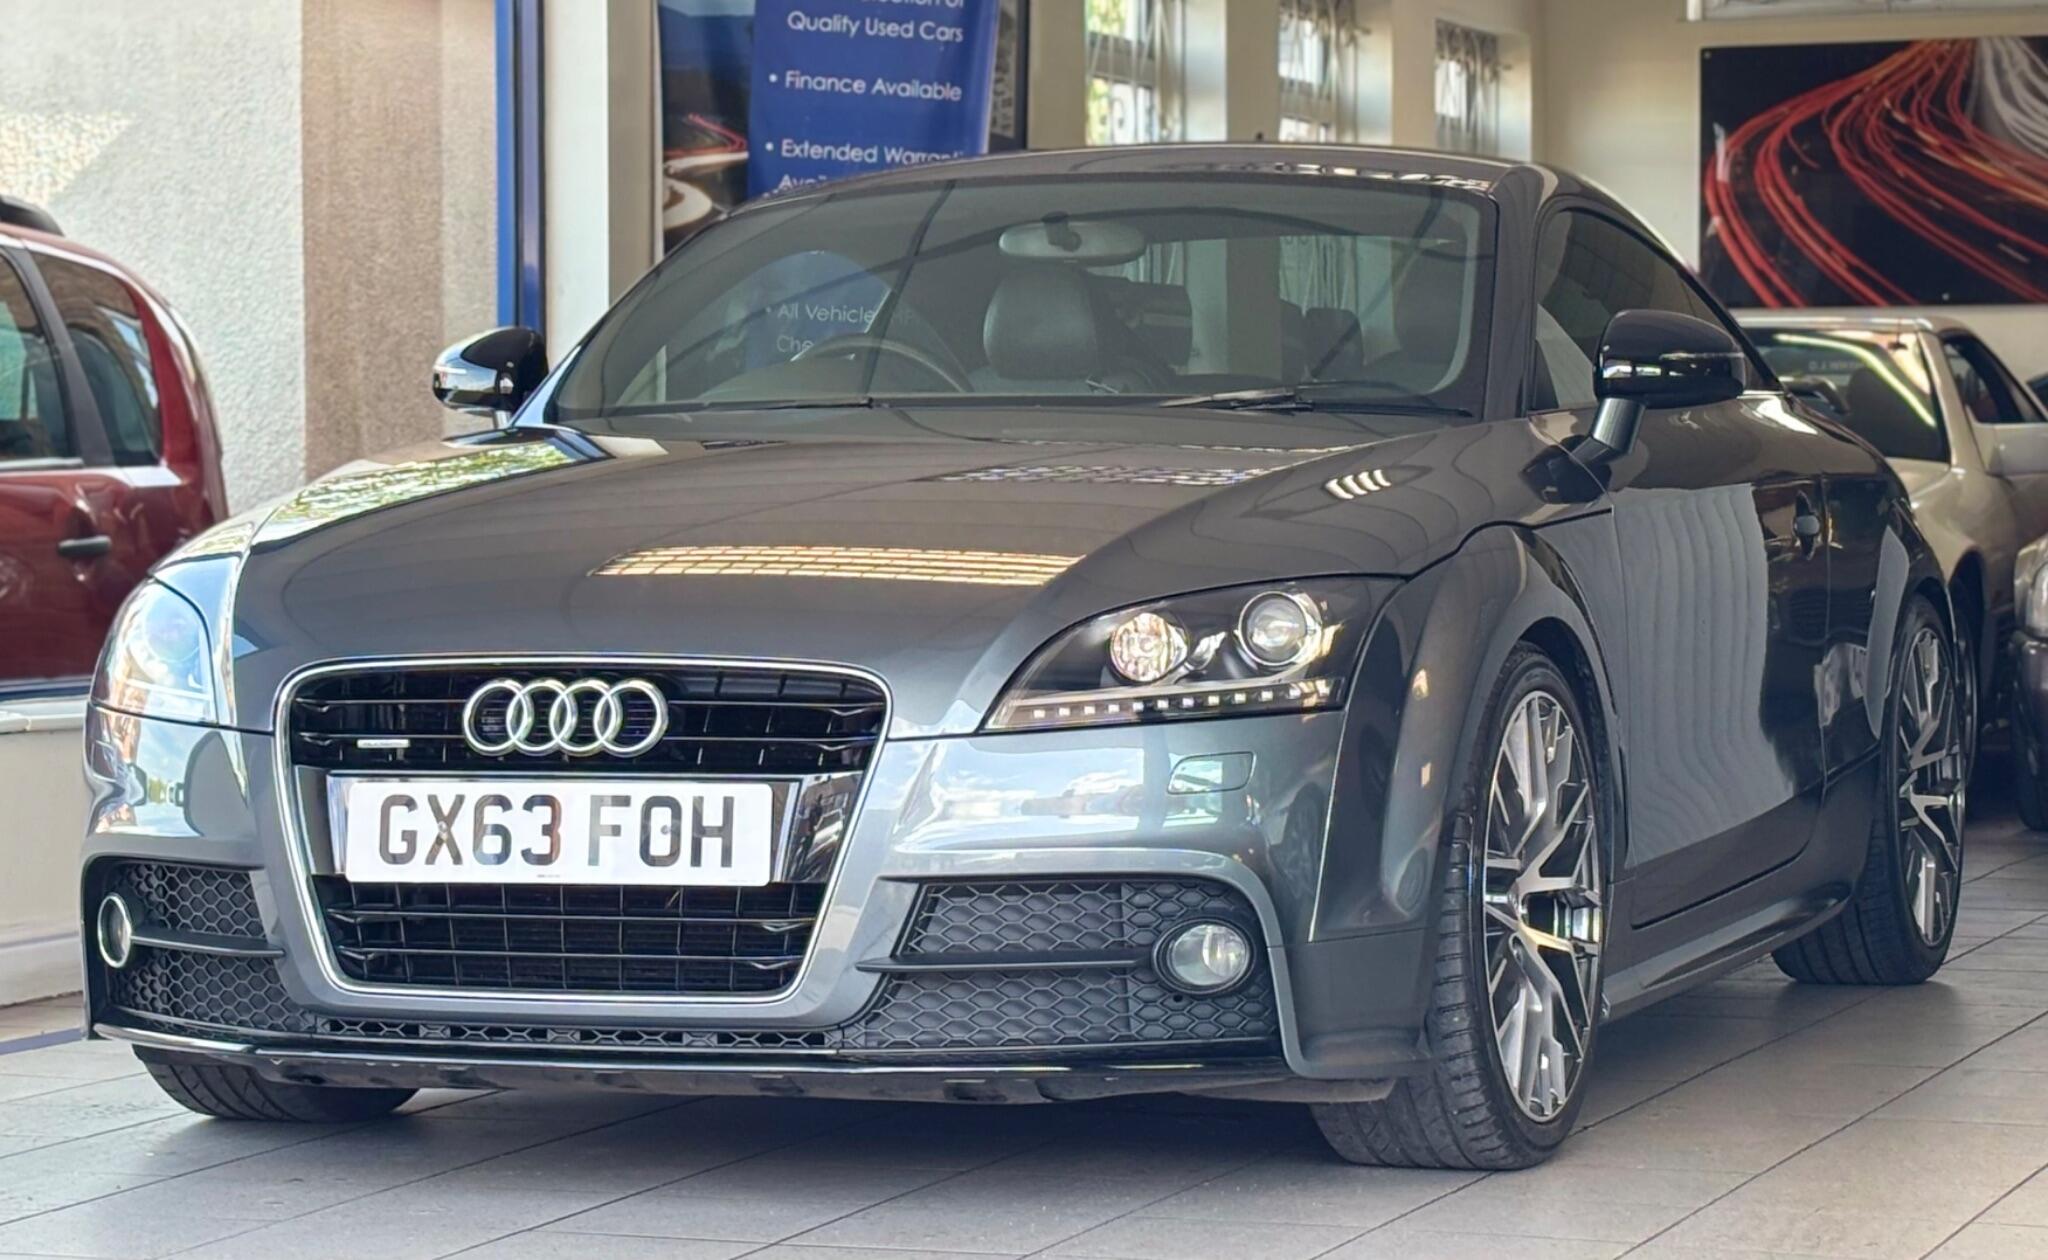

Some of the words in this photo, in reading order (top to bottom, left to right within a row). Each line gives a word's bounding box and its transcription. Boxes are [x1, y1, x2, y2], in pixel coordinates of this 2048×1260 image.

[787, 10, 860, 37] Quality
[864, 17, 914, 39] Used
[919, 21, 964, 43] Cars
[785, 70, 866, 95] Finance
[871, 77, 962, 102] Available
[781, 138, 878, 163] Extended
[777, 302, 799, 320] All
[806, 303, 876, 324] Vehicle
[776, 335, 814, 353] Che
[378, 793, 563, 867] GX63
[586, 794, 736, 869] FOH
